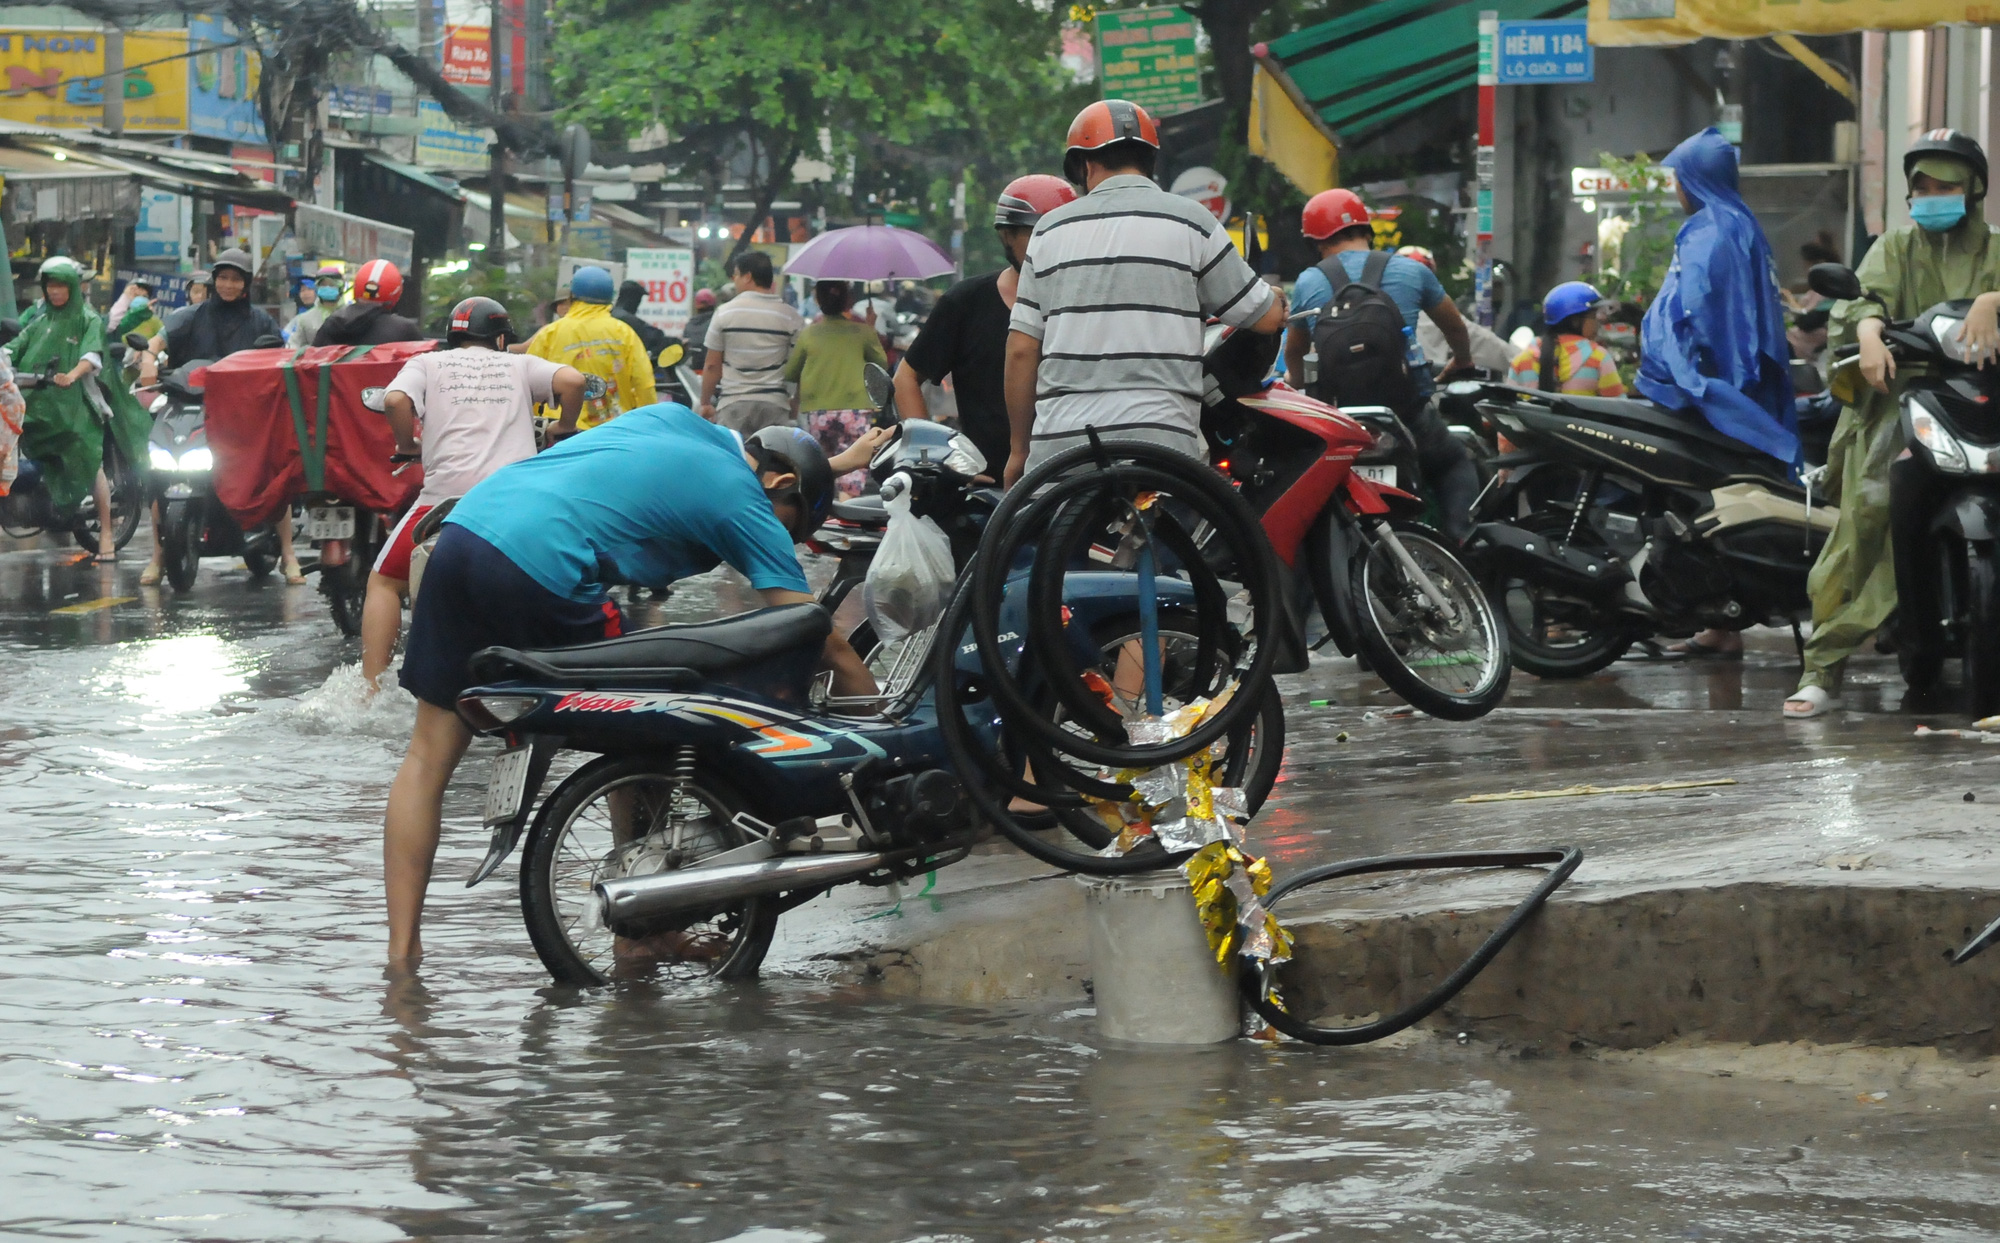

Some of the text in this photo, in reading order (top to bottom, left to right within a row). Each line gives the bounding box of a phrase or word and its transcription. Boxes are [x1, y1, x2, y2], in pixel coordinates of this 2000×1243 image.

[24, 37, 96, 53] NON
[1505, 29, 1583, 55] HẺM 184
[637, 269, 689, 304] HỞ
[553, 690, 643, 713] Wave
